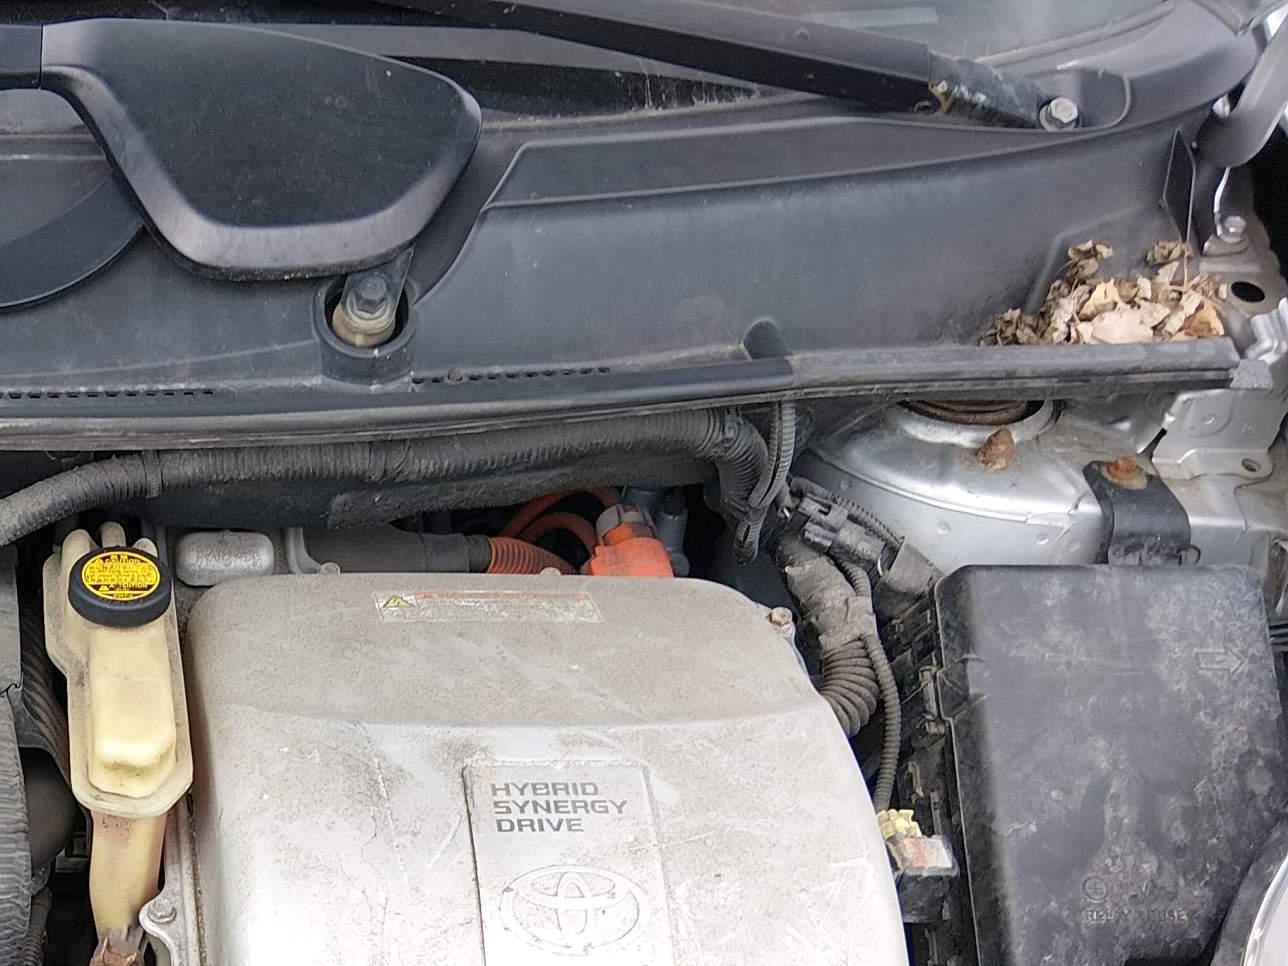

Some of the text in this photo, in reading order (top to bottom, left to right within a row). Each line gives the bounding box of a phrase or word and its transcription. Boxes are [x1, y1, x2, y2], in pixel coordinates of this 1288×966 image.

[491, 782, 599, 796] HYBRID
[493, 800, 627, 814] SYNERGY
[496, 818, 584, 832] DRIVE
